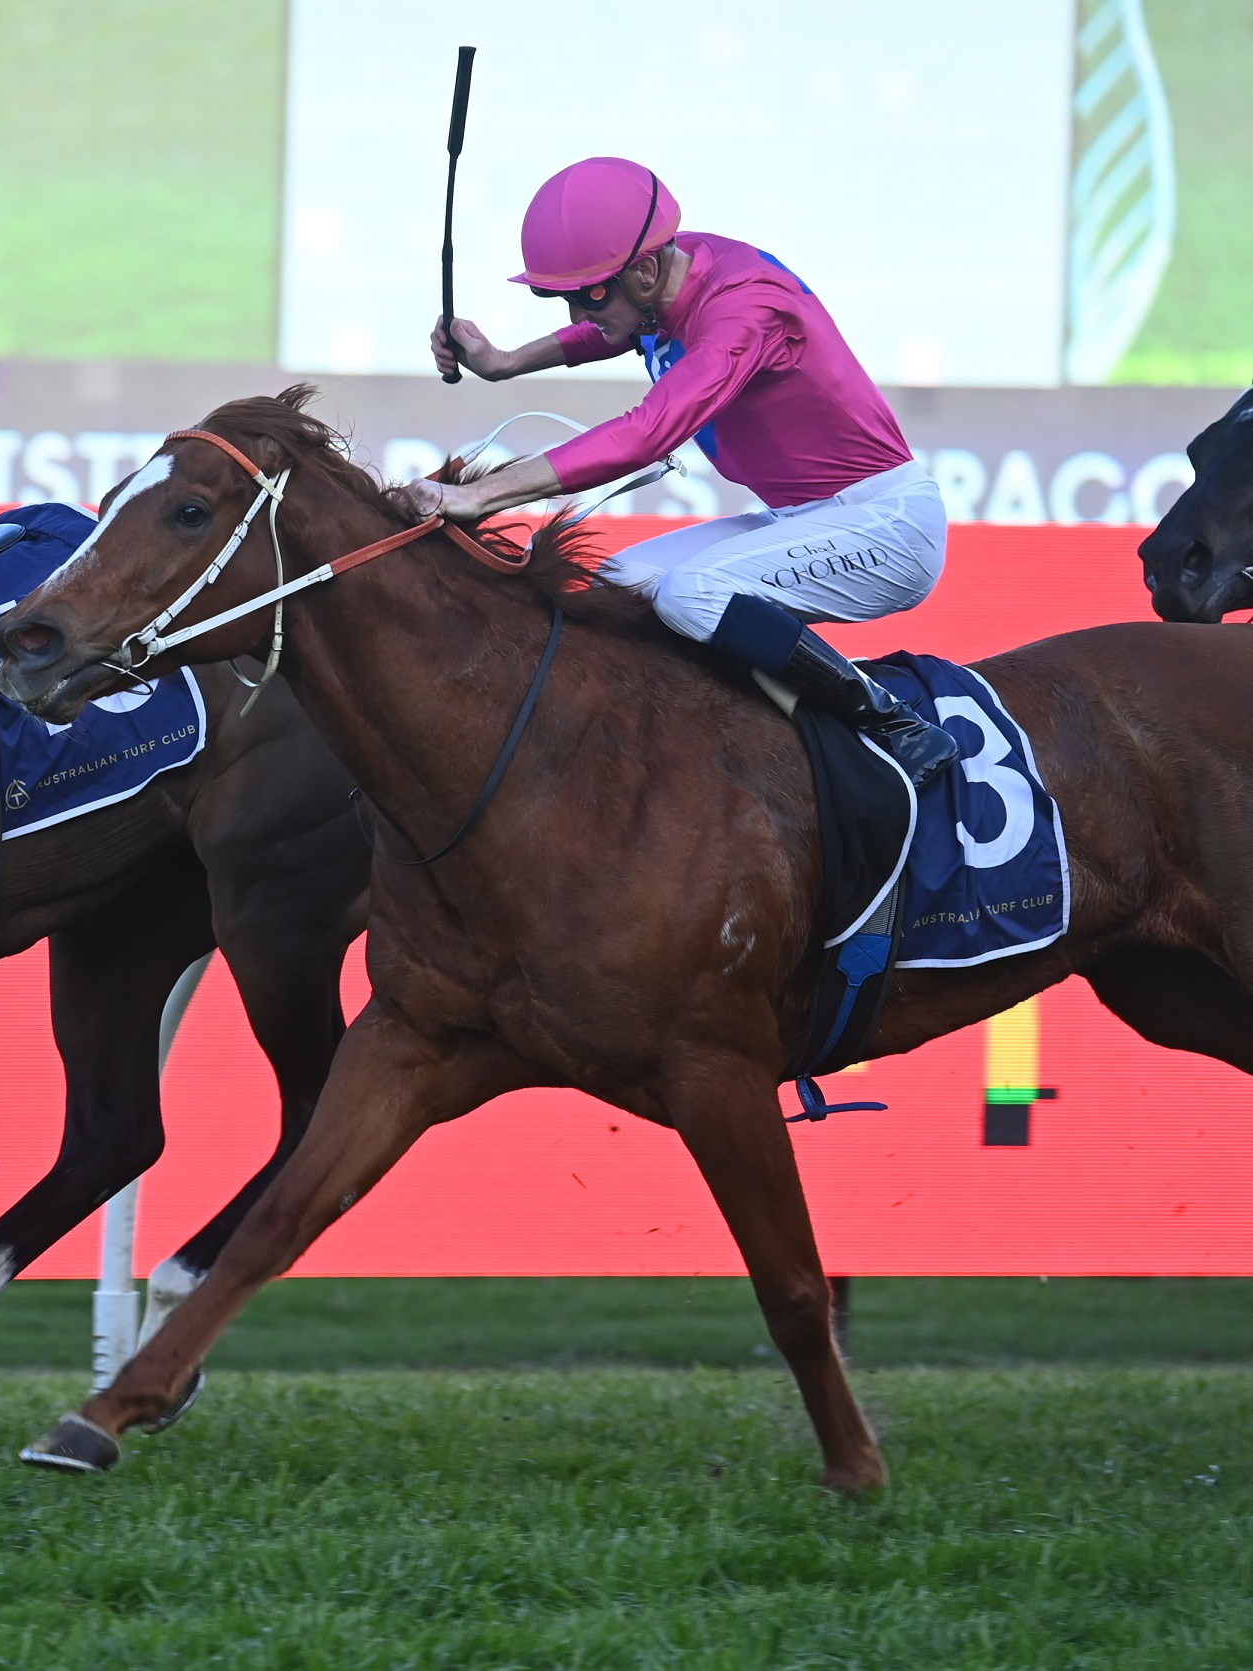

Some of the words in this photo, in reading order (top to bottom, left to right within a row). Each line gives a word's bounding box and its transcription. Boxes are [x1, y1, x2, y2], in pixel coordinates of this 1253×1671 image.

[761, 547, 888, 588] SCHOFIELD
[787, 540, 836, 558] Chad
[35, 754, 118, 791] AUSTRALIAN
[123, 739, 156, 760] TURF
[161, 724, 196, 745] CLUB
[934, 695, 1035, 868] 3
[986, 901, 1016, 915] TURF
[1022, 894, 1054, 909] CLUB
